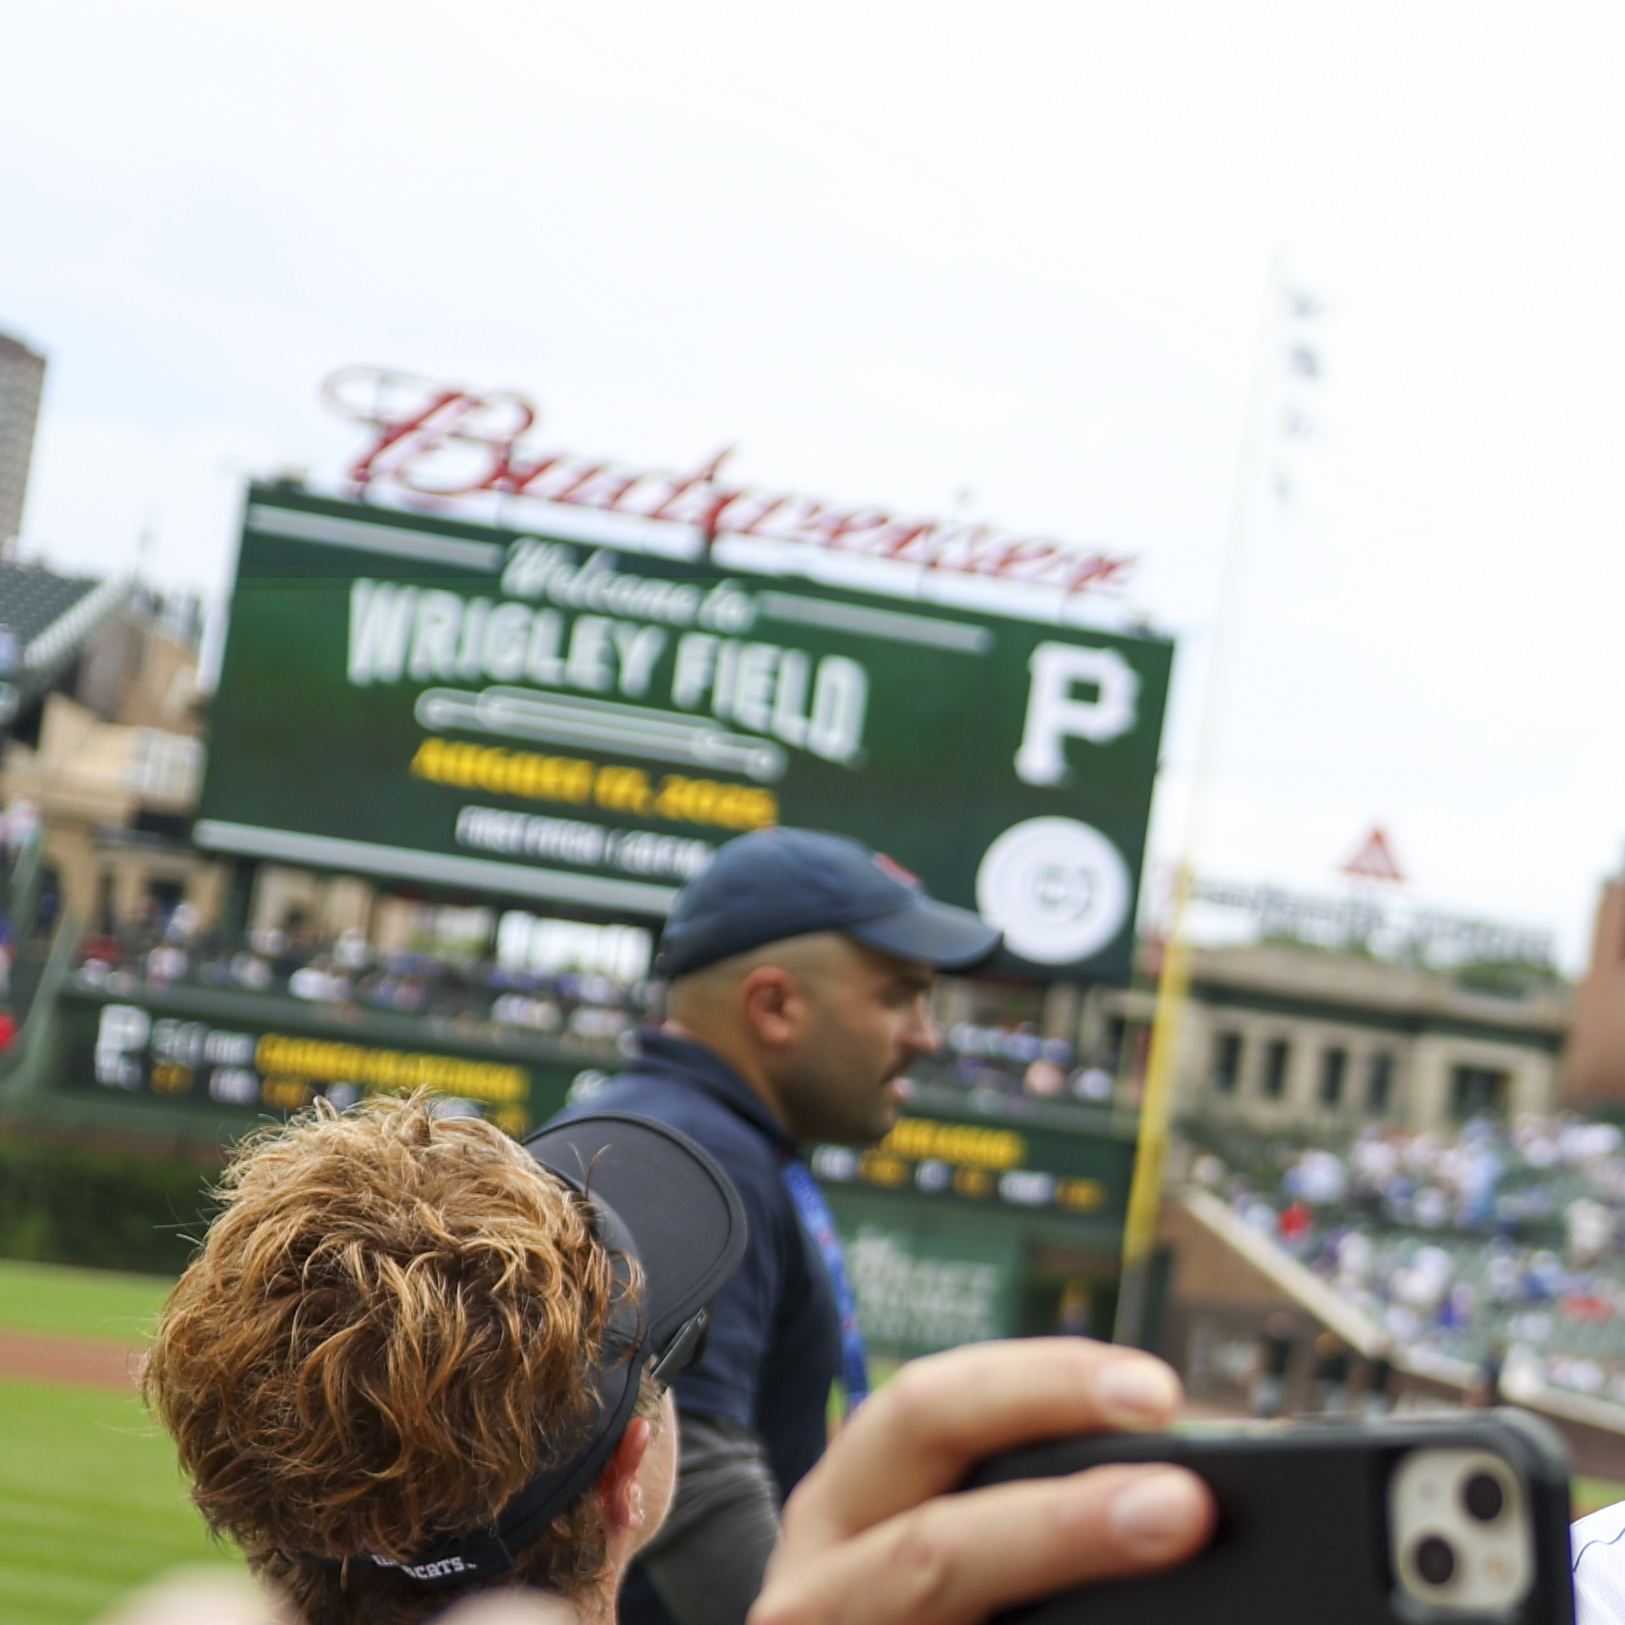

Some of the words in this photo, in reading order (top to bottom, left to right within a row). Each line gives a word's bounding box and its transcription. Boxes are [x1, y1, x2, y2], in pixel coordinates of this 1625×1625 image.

[319, 363, 1140, 591] Budweiser
[503, 536, 700, 627] Welcome
[700, 578, 757, 632] to
[347, 577, 667, 698] WRIGLEY
[671, 631, 869, 770] FIELD
[1013, 640, 1142, 787] P
